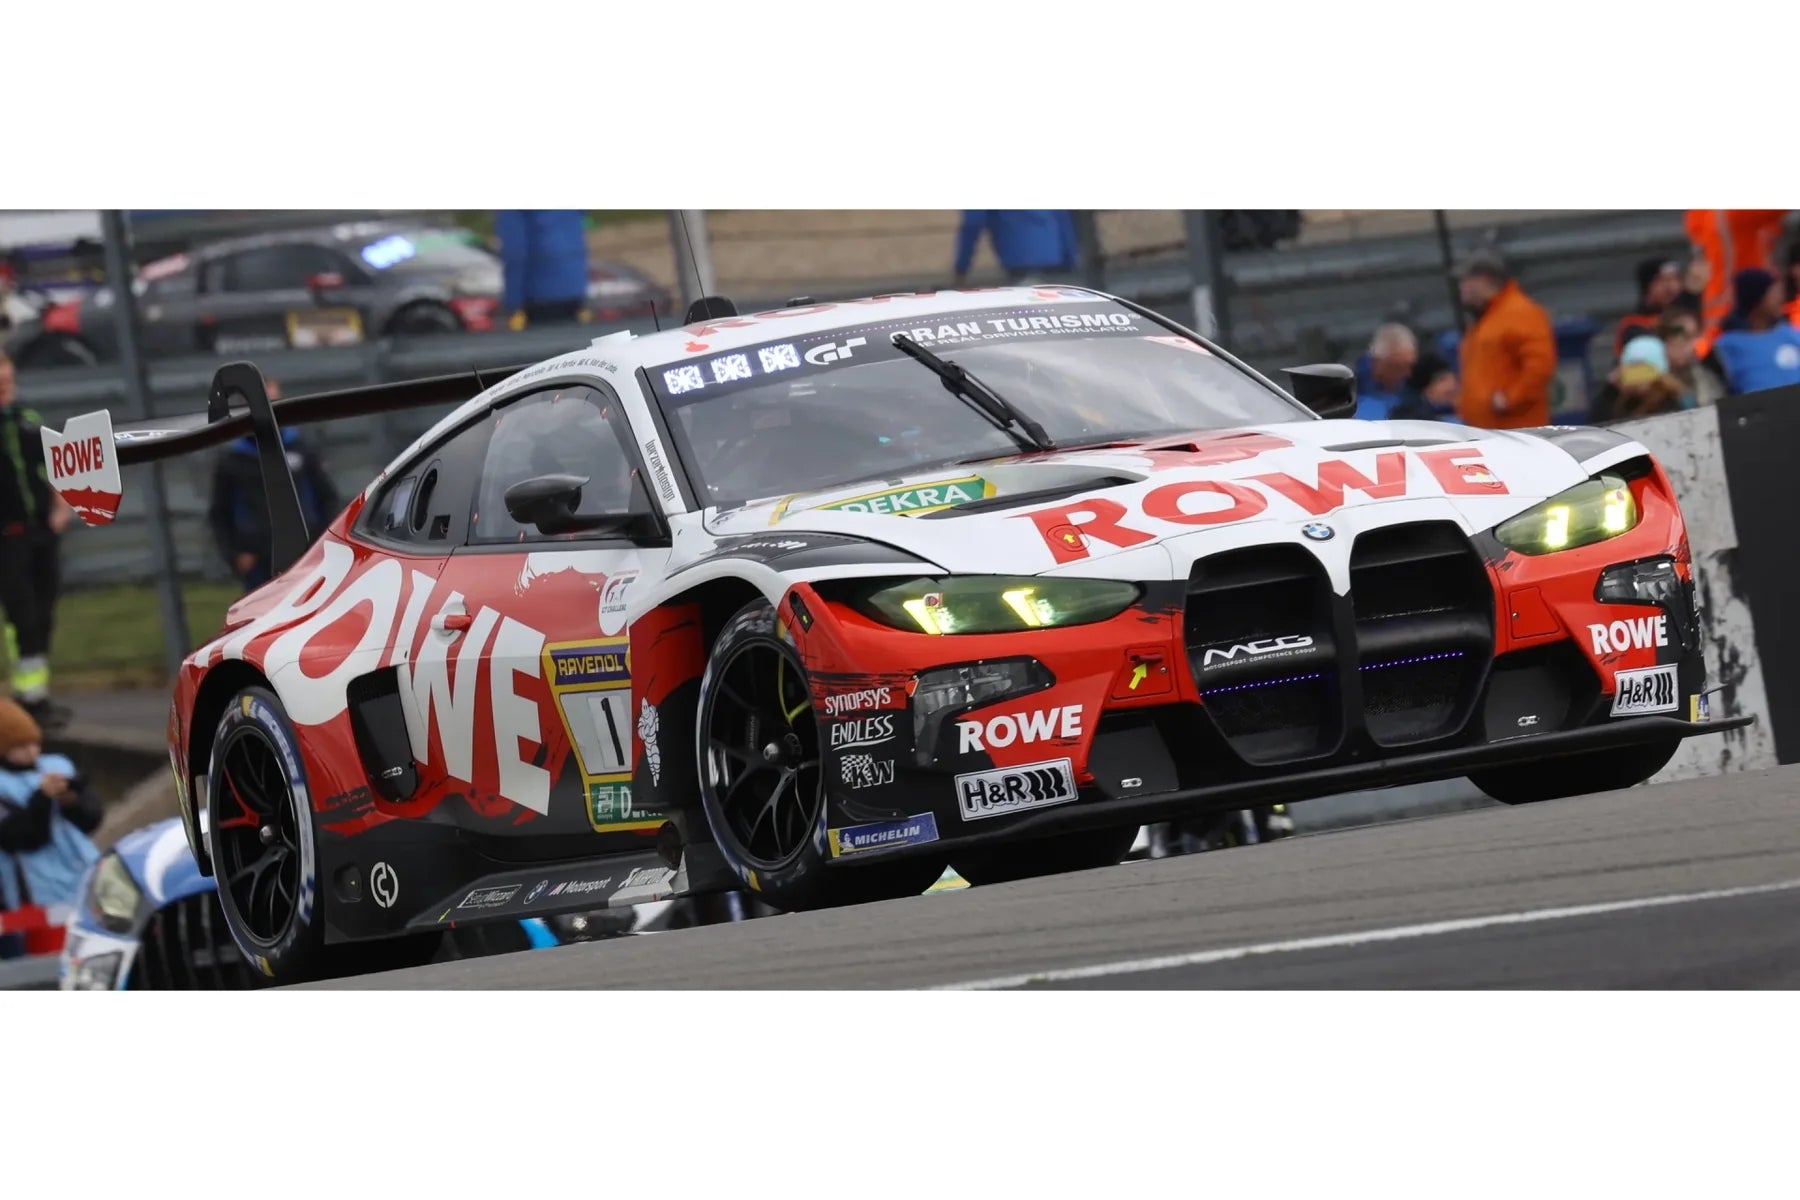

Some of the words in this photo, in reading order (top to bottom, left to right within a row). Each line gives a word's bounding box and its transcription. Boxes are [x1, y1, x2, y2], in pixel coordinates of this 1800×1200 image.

[889, 322, 981, 344] GRAN
[939, 336, 979, 347] REAL
[982, 328, 1049, 341] DRIVING
[1051, 324, 1138, 336] SIMULATOR
[50, 436, 103, 479] ROWE
[839, 484, 973, 514] DEKRA
[1008, 448, 1510, 566] ROWE
[1586, 615, 1668, 655] ROWE
[557, 654, 624, 676] RAVENOL
[1203, 658, 1248, 672] MOTORSPORT
[1249, 649, 1293, 663] COMPETENCE
[1294, 646, 1317, 655] GROUP
[194, 540, 551, 817] ROWE
[1617, 676, 1654, 709] H&R
[825, 687, 891, 716] SYNOPSYS
[600, 697, 625, 766] 1
[831, 714, 894, 747] ENDLESS
[955, 704, 1083, 754] ROWE
[850, 758, 895, 789] KW
[963, 775, 1026, 811] H&R
[854, 825, 921, 846] MICHELIN
[562, 876, 612, 896] Motorsport
